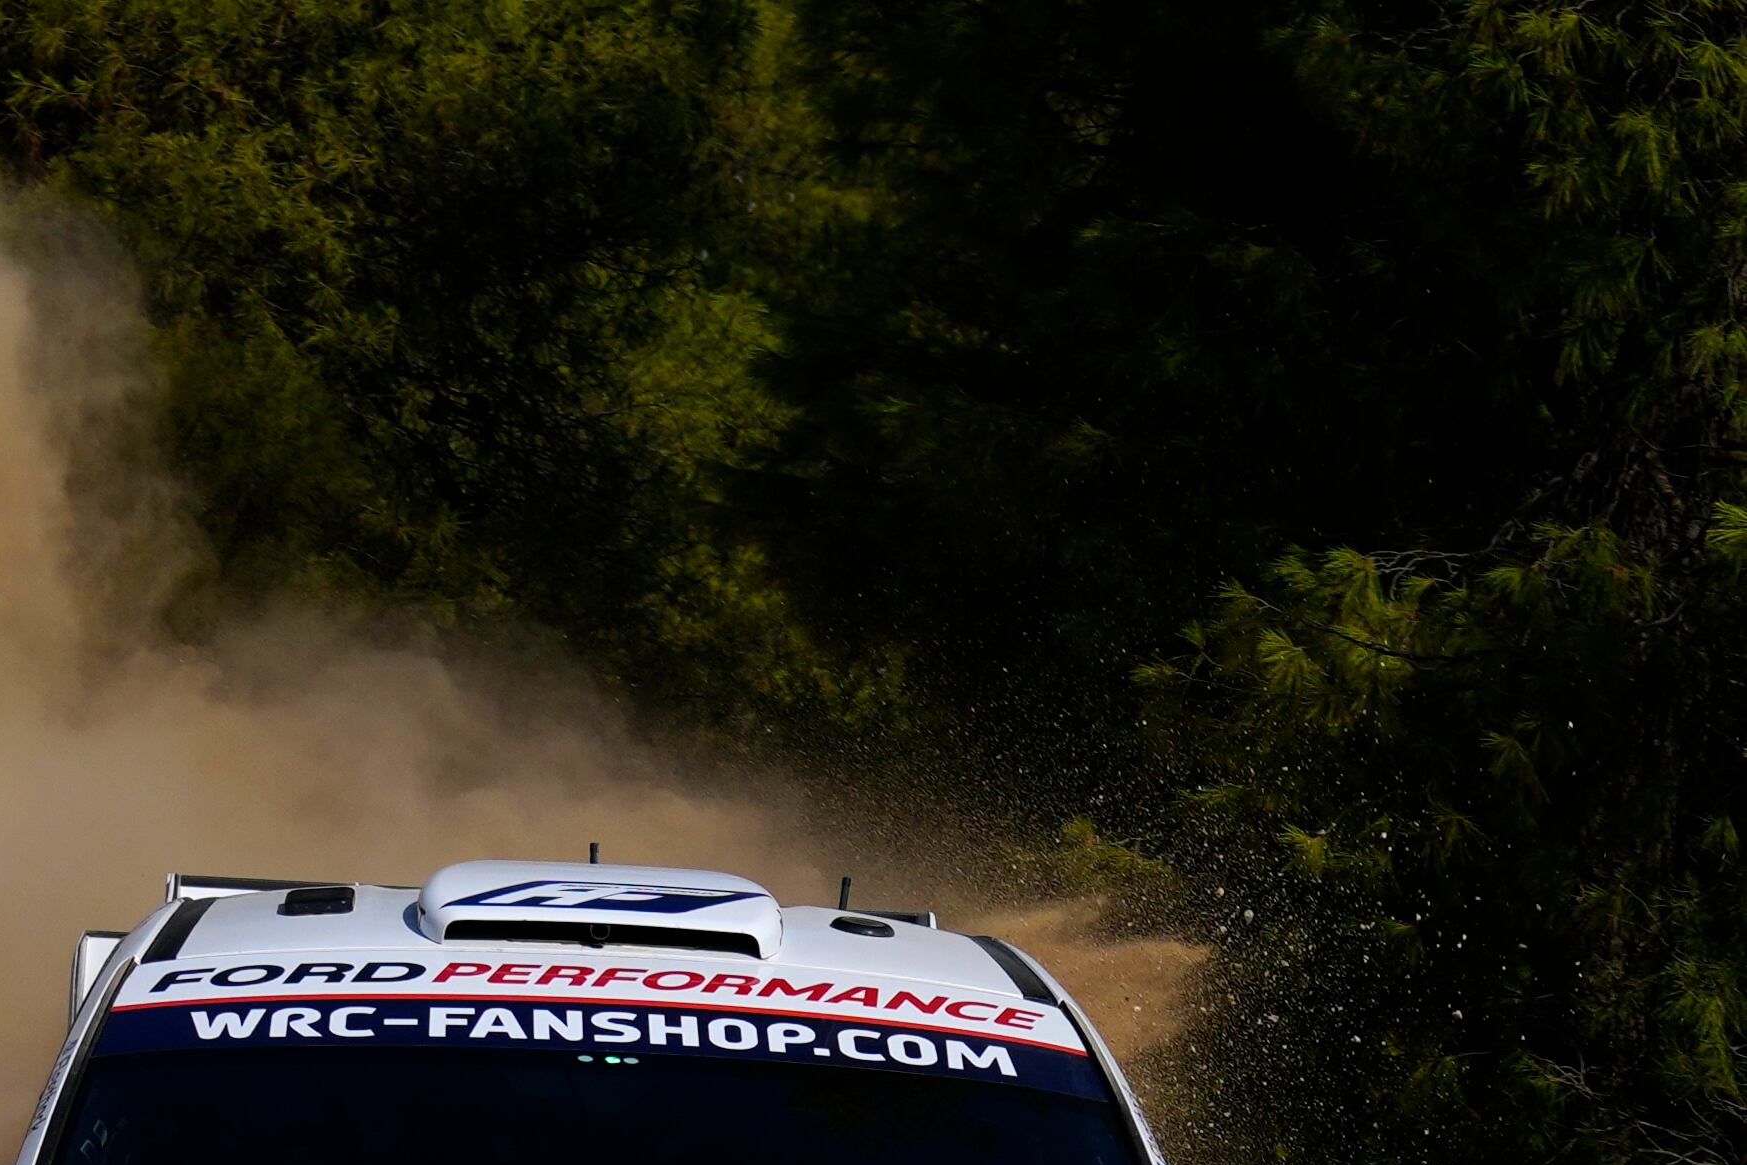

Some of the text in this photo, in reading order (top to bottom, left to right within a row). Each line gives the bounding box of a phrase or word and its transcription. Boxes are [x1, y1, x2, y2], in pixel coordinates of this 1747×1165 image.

[149, 961, 1043, 1031] FORD PERFORMANCE
[190, 1006, 1018, 1077] WRC-FANSHOP.COM
